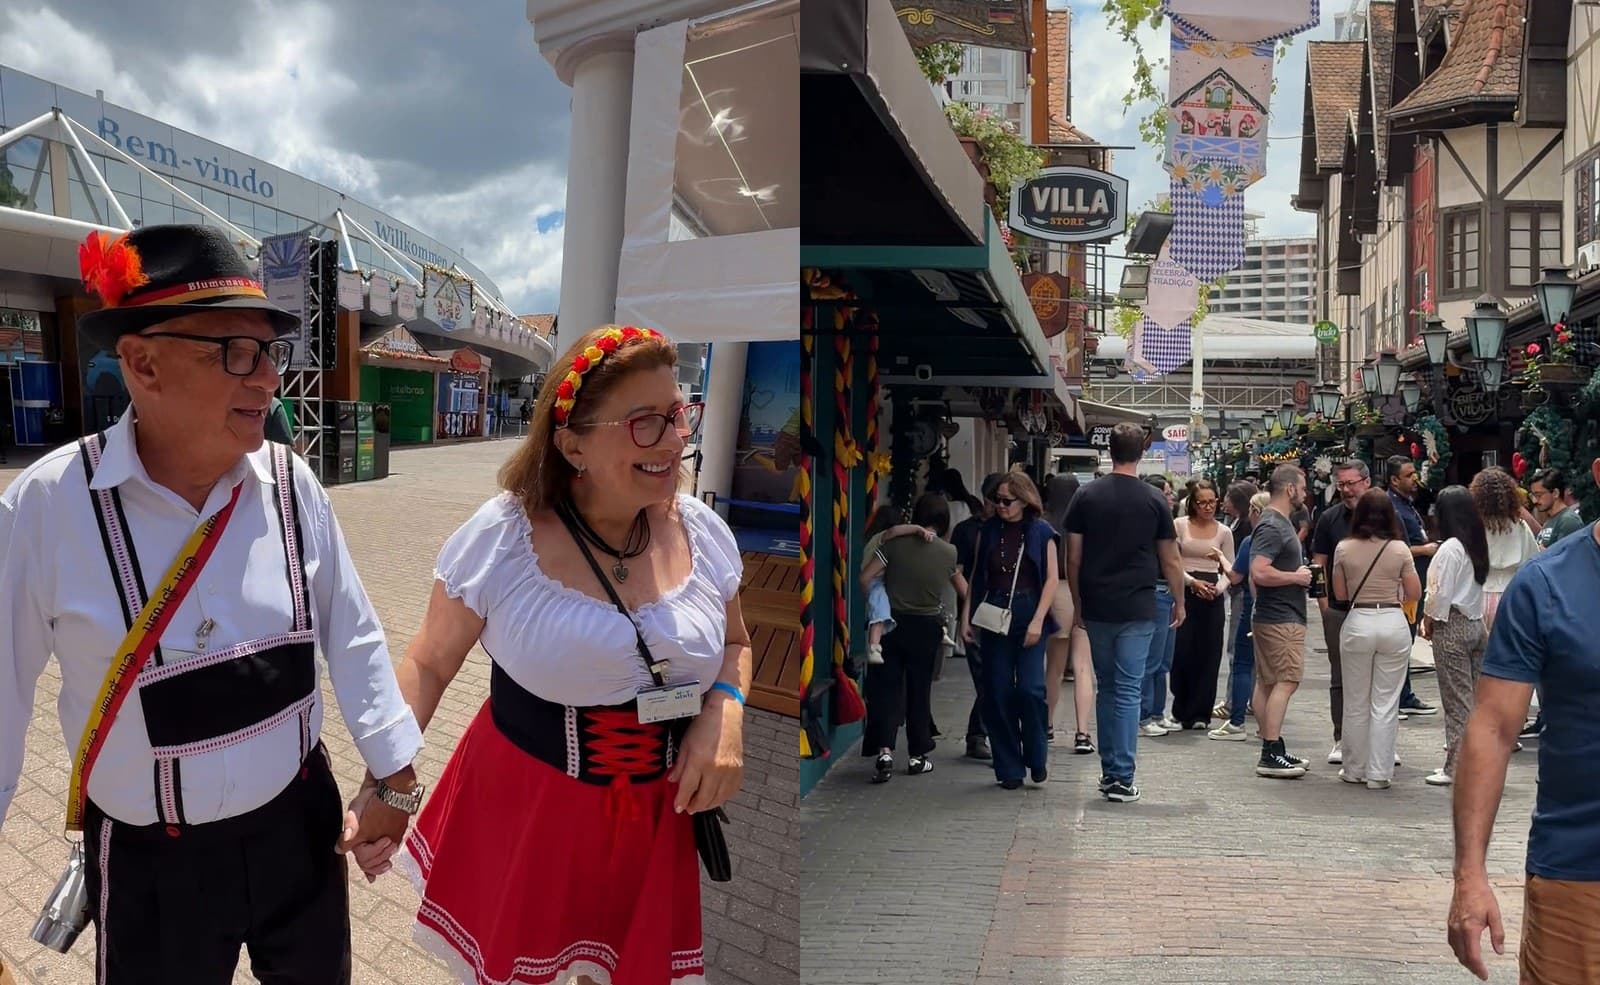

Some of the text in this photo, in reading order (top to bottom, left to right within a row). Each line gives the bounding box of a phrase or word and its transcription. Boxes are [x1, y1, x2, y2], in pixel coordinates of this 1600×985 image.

[98, 117, 274, 198] Bem-vindo
[1031, 186, 1109, 214] VILLA
[1049, 217, 1085, 226] STORE
[374, 220, 448, 268] Willkommen
[1152, 277, 1193, 288] TRADIÇÃO
[1167, 427, 1187, 438] SAÍD
[1091, 434, 1111, 445] ALE
